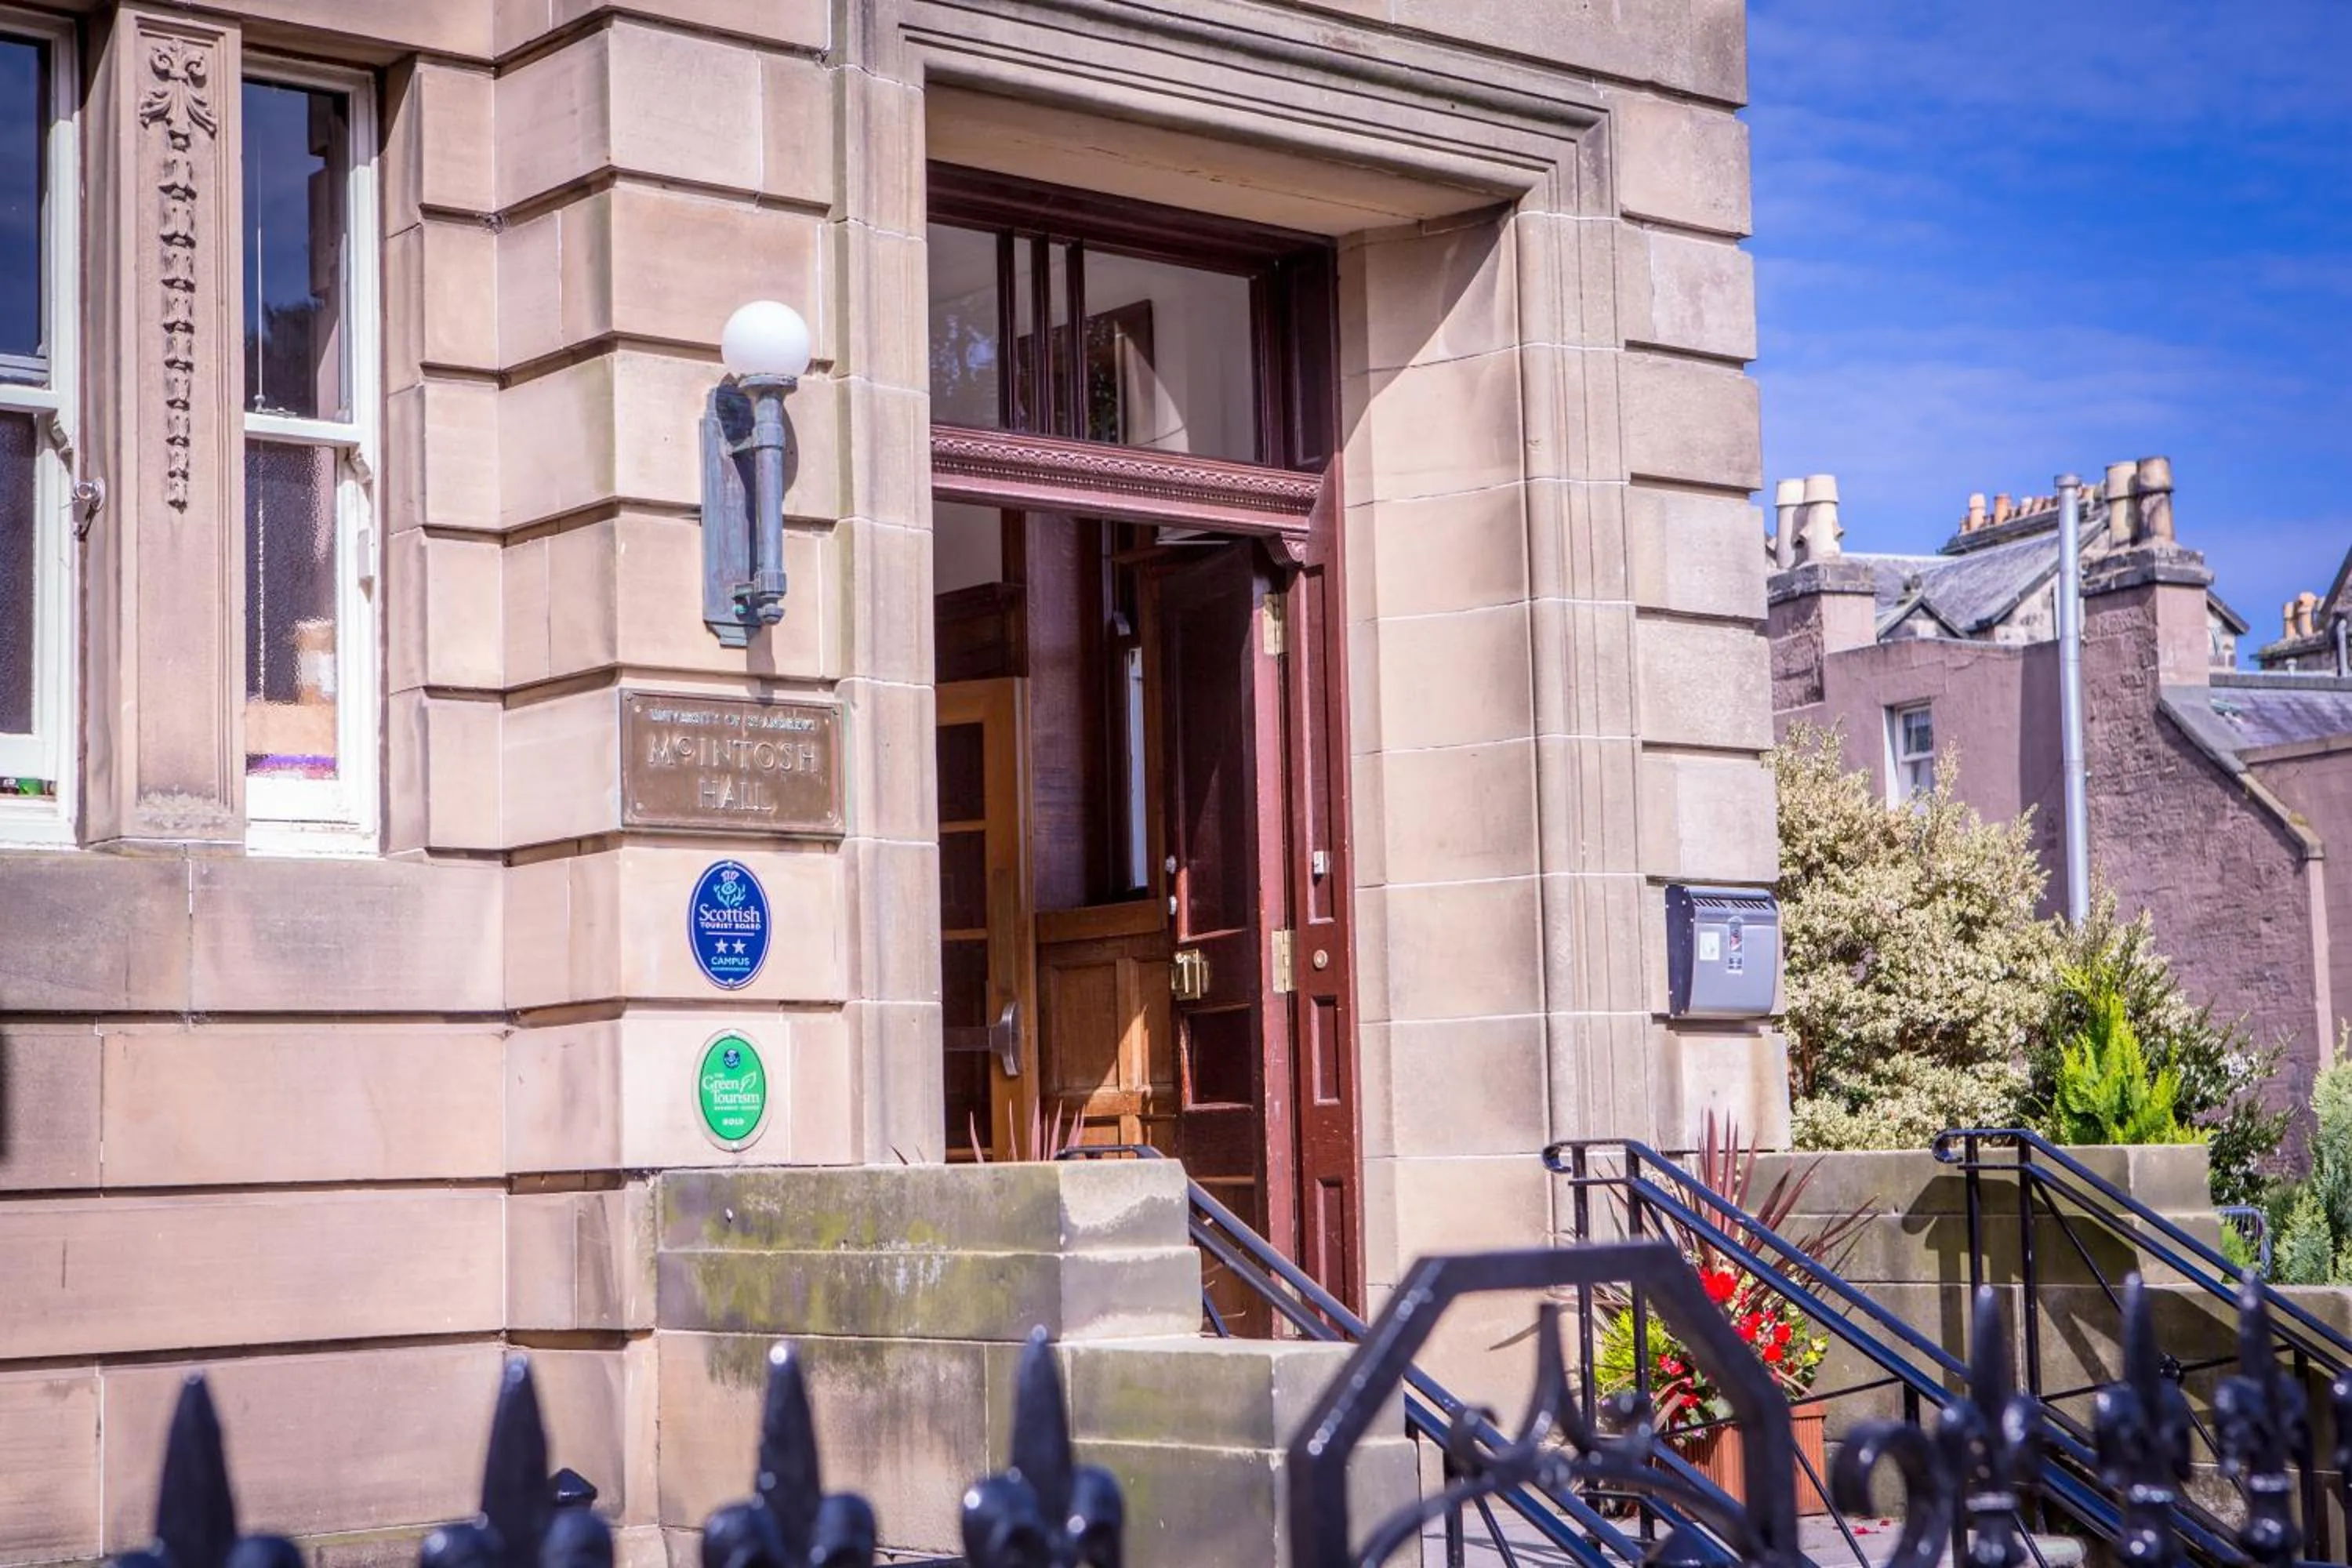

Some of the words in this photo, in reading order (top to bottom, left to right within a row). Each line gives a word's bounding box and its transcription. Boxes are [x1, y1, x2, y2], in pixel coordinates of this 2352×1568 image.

[699, 774, 773, 813] HALL
[699, 903, 760, 923] Scottish
[711, 956, 750, 966] CAMPUS
[702, 1073, 739, 1091] Green
[711, 1089, 760, 1105] Tourism
